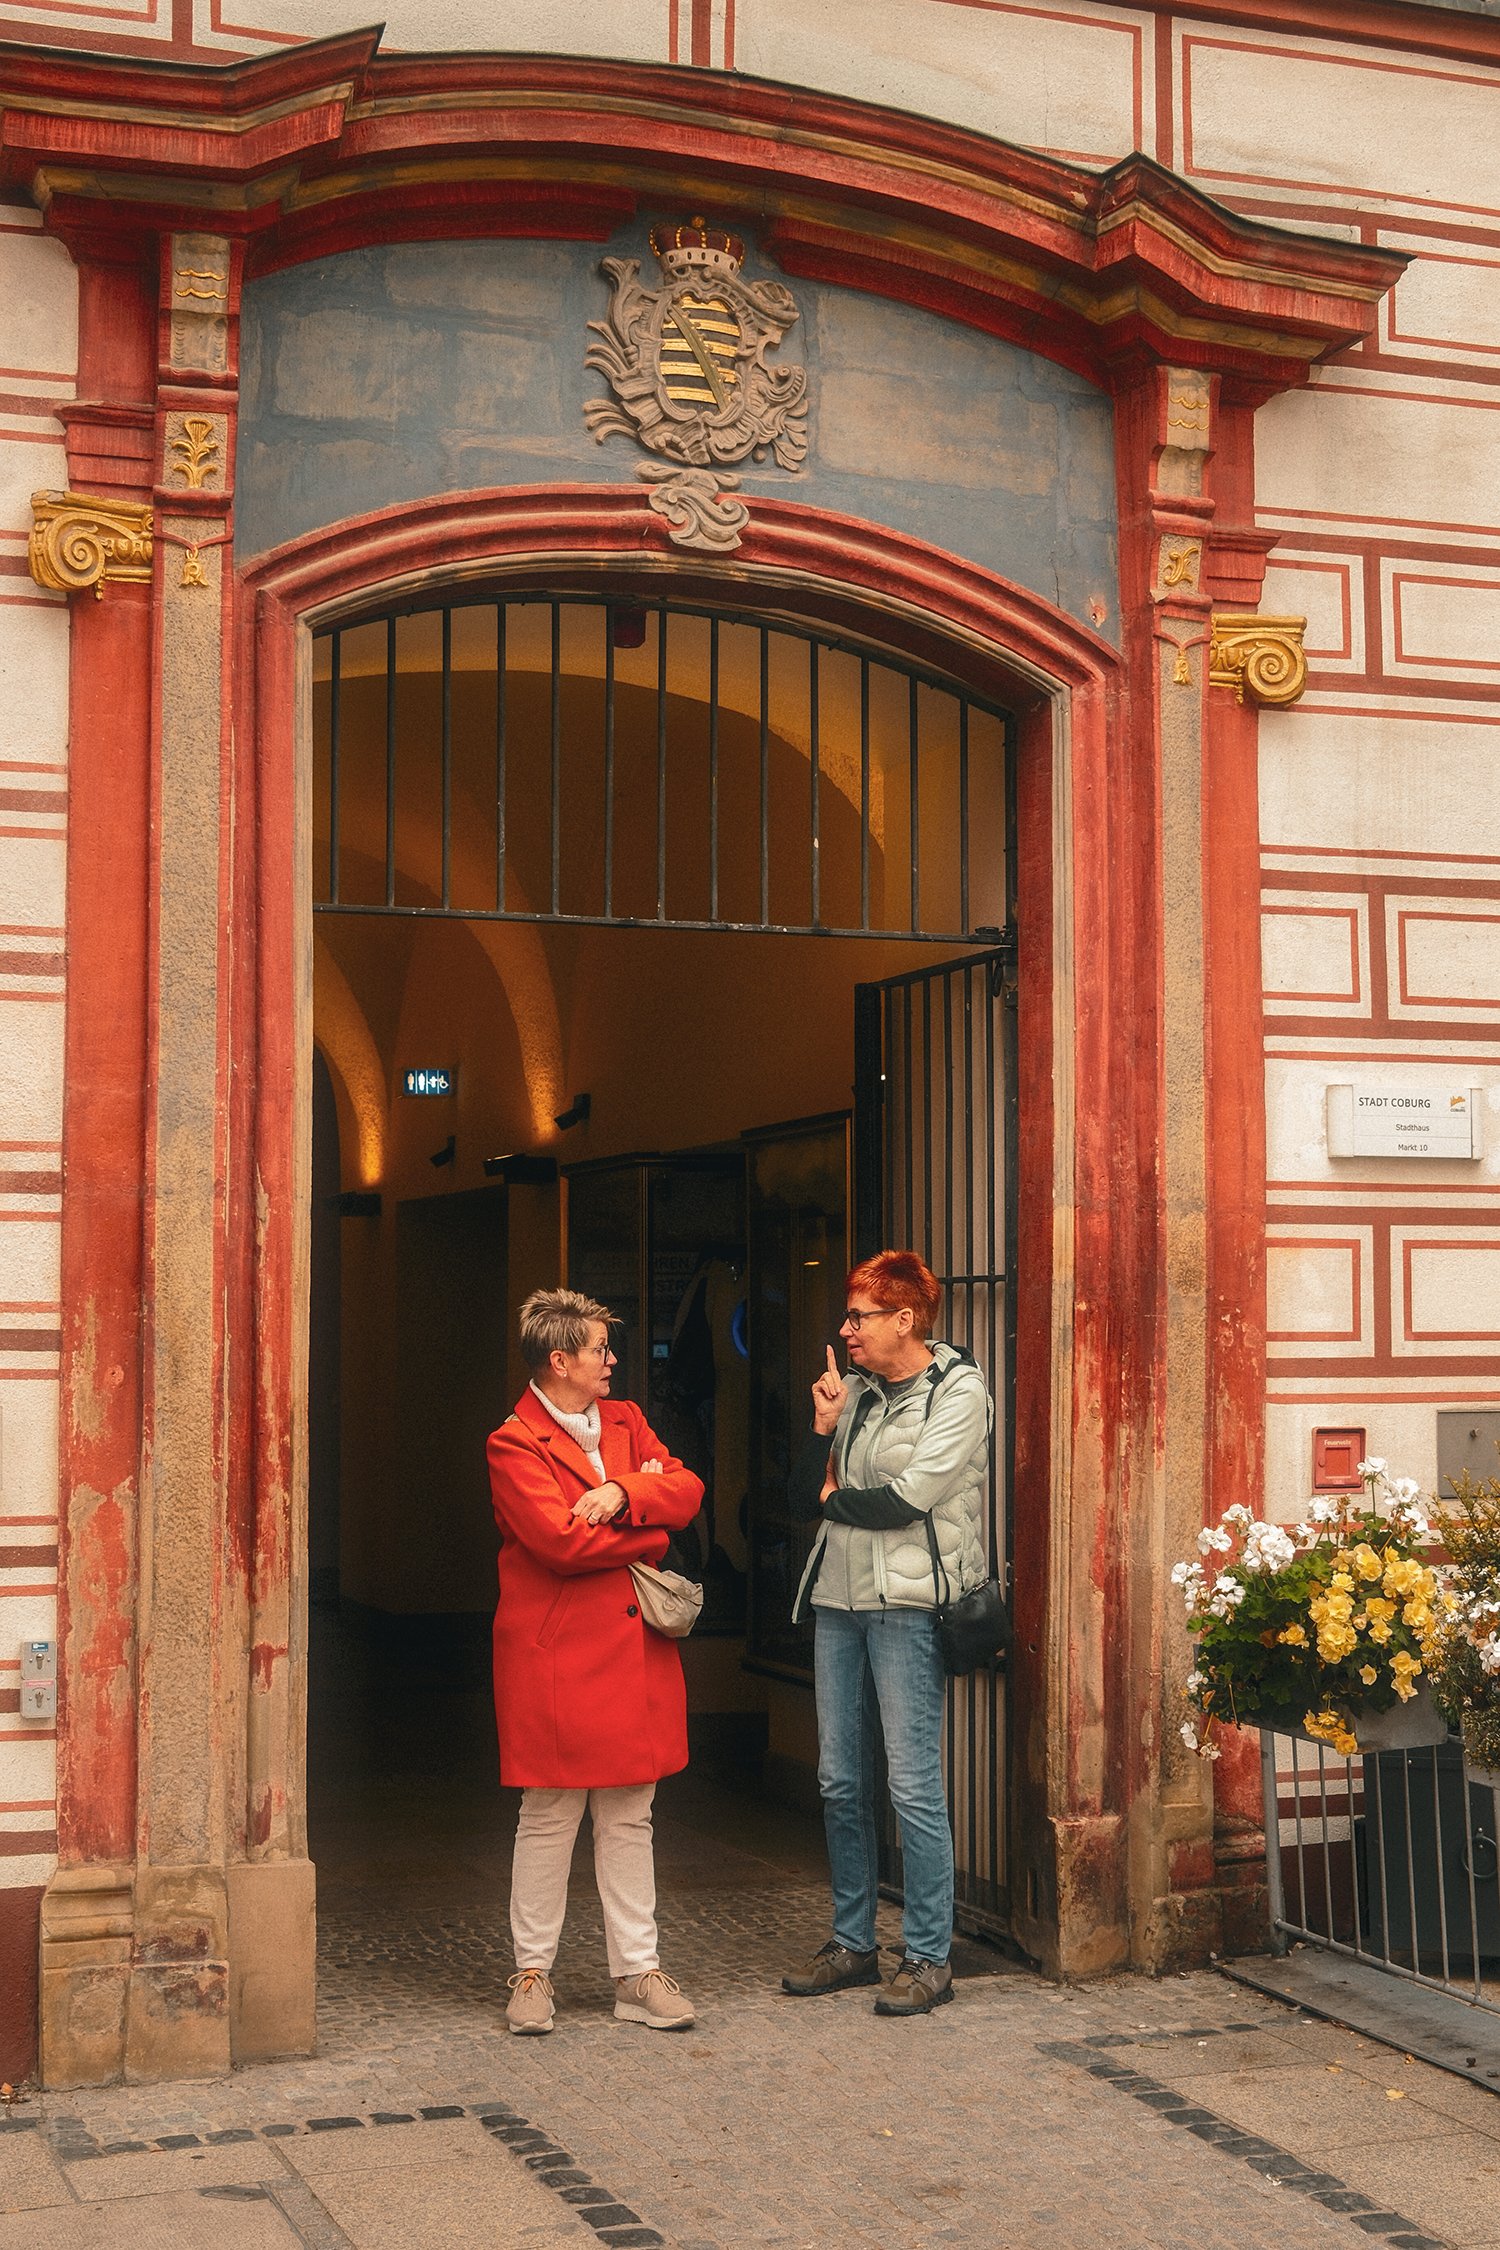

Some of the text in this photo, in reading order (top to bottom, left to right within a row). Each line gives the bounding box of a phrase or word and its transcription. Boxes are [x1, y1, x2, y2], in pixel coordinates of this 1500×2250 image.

[1358, 1097, 1431, 1108] STADT COBURG
[1395, 1123, 1430, 1131] Stadthaus
